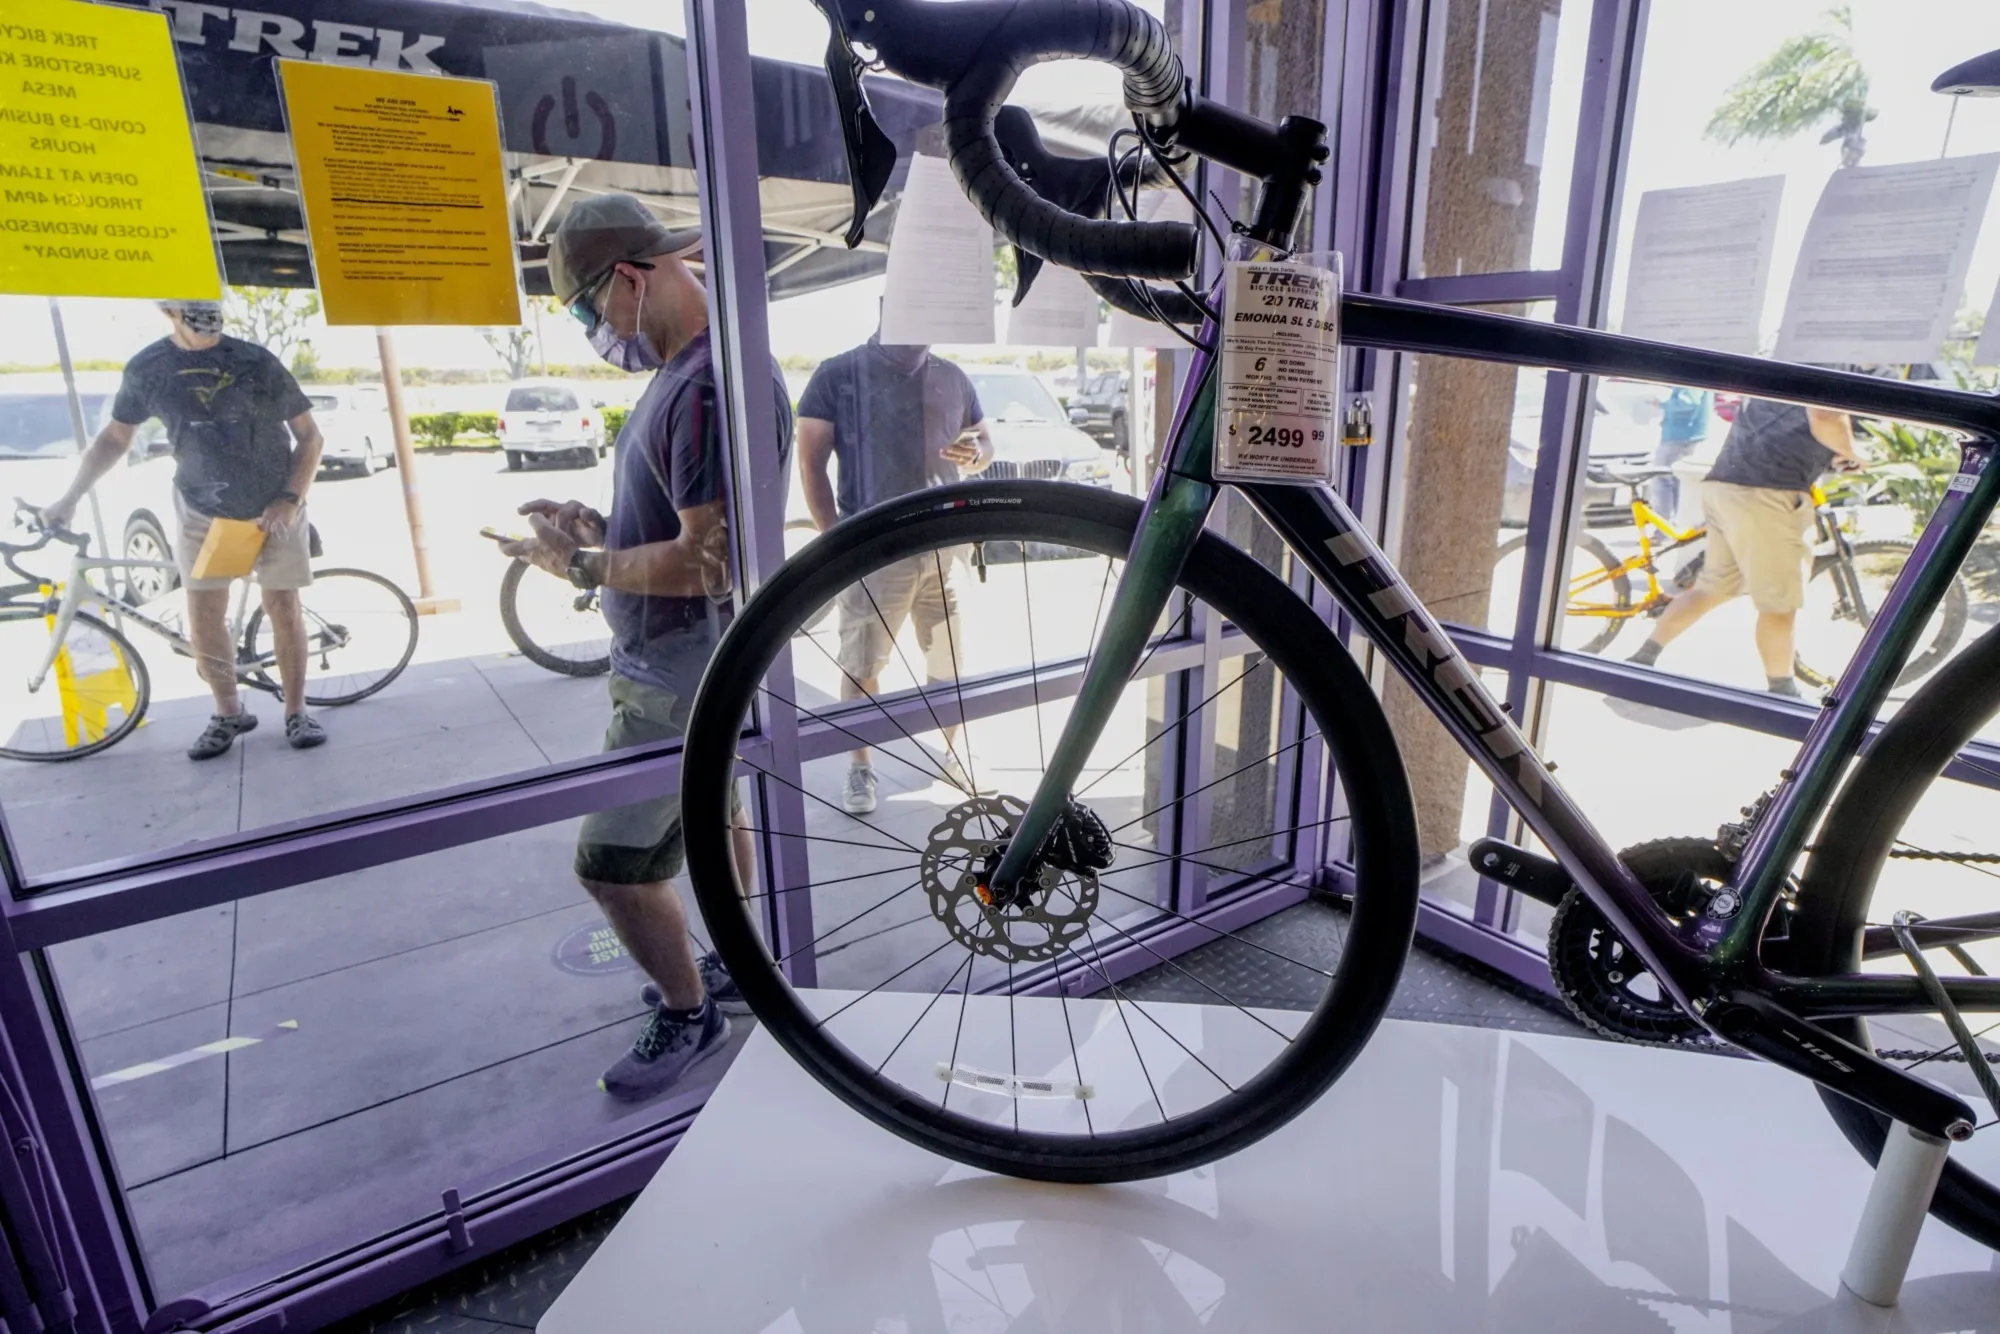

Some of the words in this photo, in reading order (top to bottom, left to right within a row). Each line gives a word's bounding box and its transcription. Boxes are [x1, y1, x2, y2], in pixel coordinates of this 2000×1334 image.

[150, 0, 446, 76] TREK
[1247, 271, 1324, 290] TREK
[1249, 284, 1284, 292] BICYCLE
[1288, 297, 1319, 311] TREK
[1234, 312, 1287, 324] EMONDA
[1290, 316, 1304, 326] SL
[1306, 318, 1313, 328] 5
[1254, 356, 1267, 372] 6
[1228, 424, 1237, 436] $
[1248, 426, 1304, 448] 2499
[1312, 430, 1324, 440] 99
[1323, 501, 1550, 807] TREK
[589, 938, 621, 952] AND
[589, 947, 629, 964] EASE
